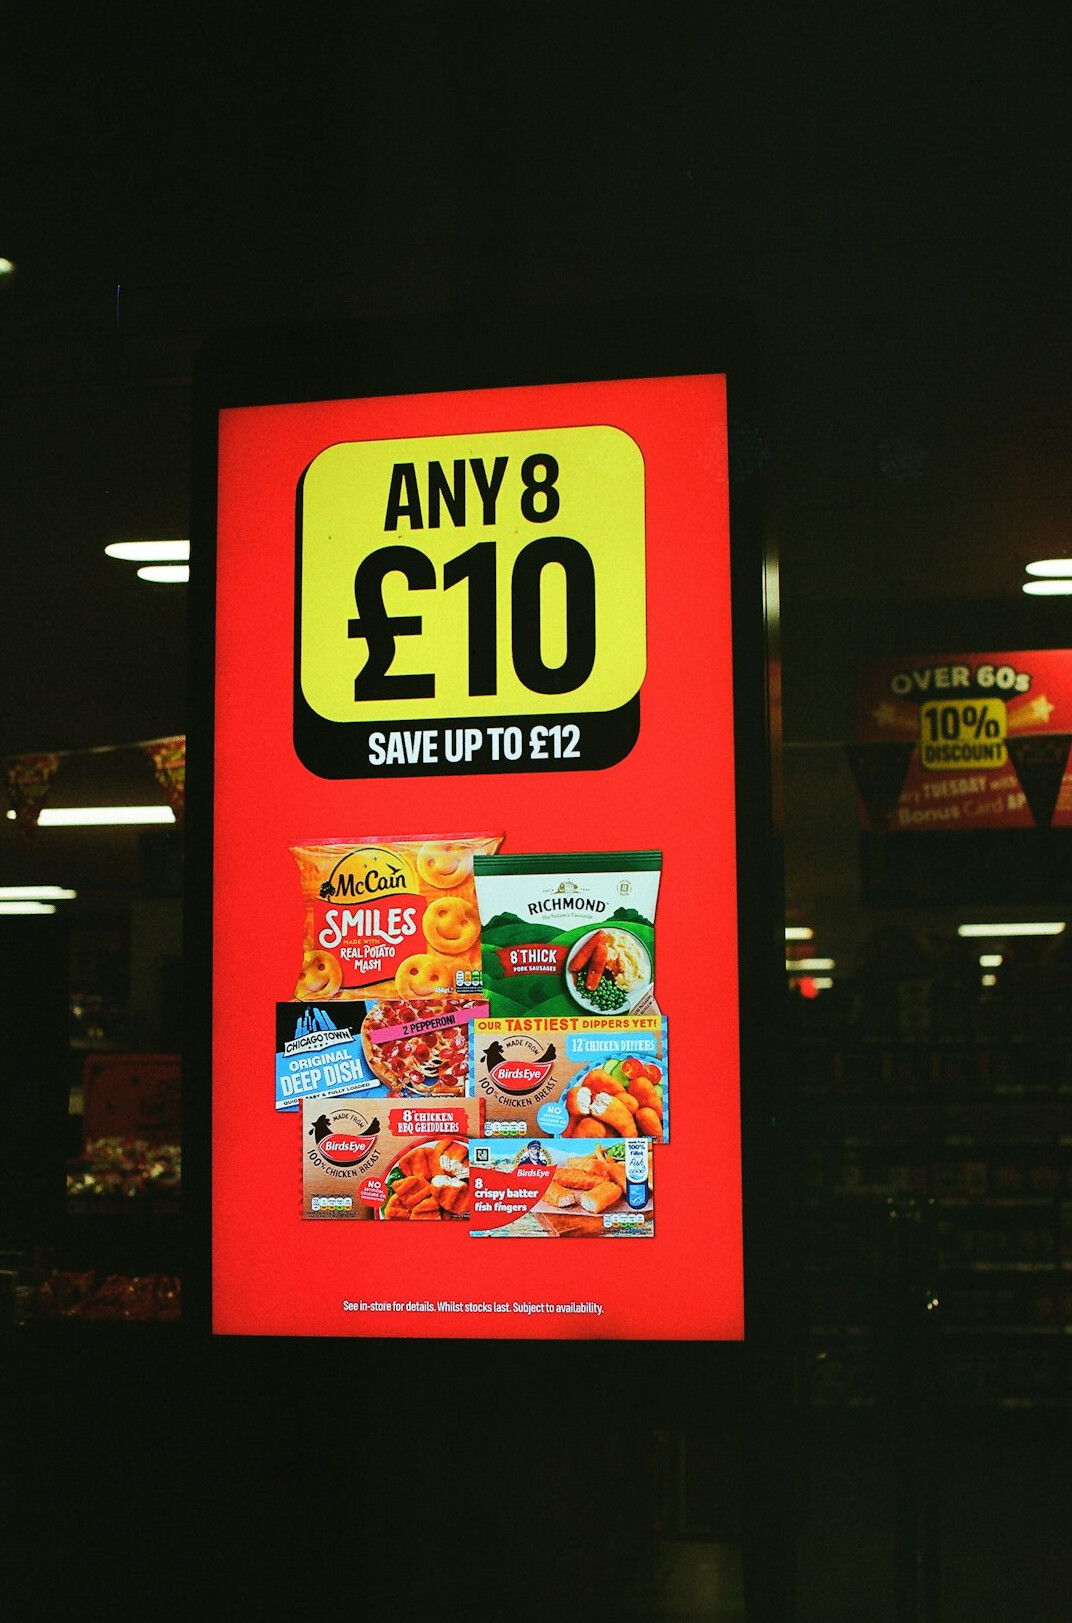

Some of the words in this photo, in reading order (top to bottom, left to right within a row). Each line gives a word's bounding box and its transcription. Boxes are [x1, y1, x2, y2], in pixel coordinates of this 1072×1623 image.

[384, 456, 509, 532] ANY
[520, 453, 560, 524] 8
[347, 536, 596, 702] £10
[890, 665, 971, 695] OVER
[976, 665, 1031, 693] 60s
[924, 706, 1001, 741] 10%
[368, 728, 438, 766] SAVE
[445, 728, 483, 761] UP
[486, 726, 523, 761] TO
[529, 724, 581, 760] £12
[925, 744, 1002, 763] DISCOUNT
[923, 776, 987, 798] TUESDAY
[898, 807, 960, 825] Bonus
[963, 798, 1003, 816] Card
[335, 870, 407, 897] McCain
[528, 898, 606, 915] RICHMOND
[318, 908, 417, 948] SMILES
[340, 948, 363, 961] REAL
[363, 944, 395, 958] POTATO
[510, 950, 518, 963] 8
[522, 949, 557, 963] THICK
[354, 959, 381, 974] MASH
[403, 1026, 409, 1034] 2
[410, 1014, 456, 1034] PEPPERONI
[478, 1021, 501, 1029] OUR
[505, 1018, 579, 1031] TASTIEST
[582, 1019, 629, 1029] DIPPERS
[632, 1019, 657, 1028] YET!
[286, 1035, 324, 1053] CHICAGO
[324, 1030, 350, 1043] TOWN
[506, 1039, 524, 1048] MADE
[526, 1040, 539, 1055] FROM
[572, 1038, 583, 1052] 12
[584, 1039, 618, 1052] CHICKEN
[621, 1038, 655, 1052] DIPPERS
[289, 1049, 352, 1071] ORIGINAL
[280, 1068, 323, 1096] DEEP
[326, 1058, 364, 1087] DISH
[498, 1068, 541, 1081] BirdsEye
[346, 1083, 370, 1091] LOADED
[479, 1077, 498, 1099] 100%
[498, 1095, 533, 1108] CHICKEN
[535, 1077, 558, 1102] BREAST
[403, 1110, 412, 1122] 8
[414, 1113, 453, 1122] CHICKEN
[547, 1106, 561, 1115] NO
[332, 1113, 349, 1121] MADE
[351, 1114, 365, 1128] FROM
[398, 1122, 413, 1134] BBQ
[415, 1122, 459, 1132] GRIDDLERS
[325, 1141, 366, 1151] BirdsEye
[307, 1149, 326, 1170] 100%
[325, 1167, 358, 1178] CHICKEN
[360, 1149, 382, 1173] BREAST
[517, 1168, 550, 1179] BirdsEye
[475, 1178, 483, 1189] 8
[474, 1188, 505, 1202] crispy
[506, 1188, 538, 1198] batter
[475, 1201, 493, 1212] fish
[494, 1202, 527, 1215] fingers
[343, 1300, 359, 1311] See
[360, 1300, 391, 1312] in-store
[392, 1301, 405, 1312] for
[406, 1301, 436, 1312] details.
[437, 1301, 463, 1313] Whilst
[465, 1301, 492, 1313] stocks
[493, 1301, 512, 1313] last.
[513, 1302, 544, 1315] Subject
[545, 1303, 554, 1313] to
[556, 1302, 605, 1315] availability.
